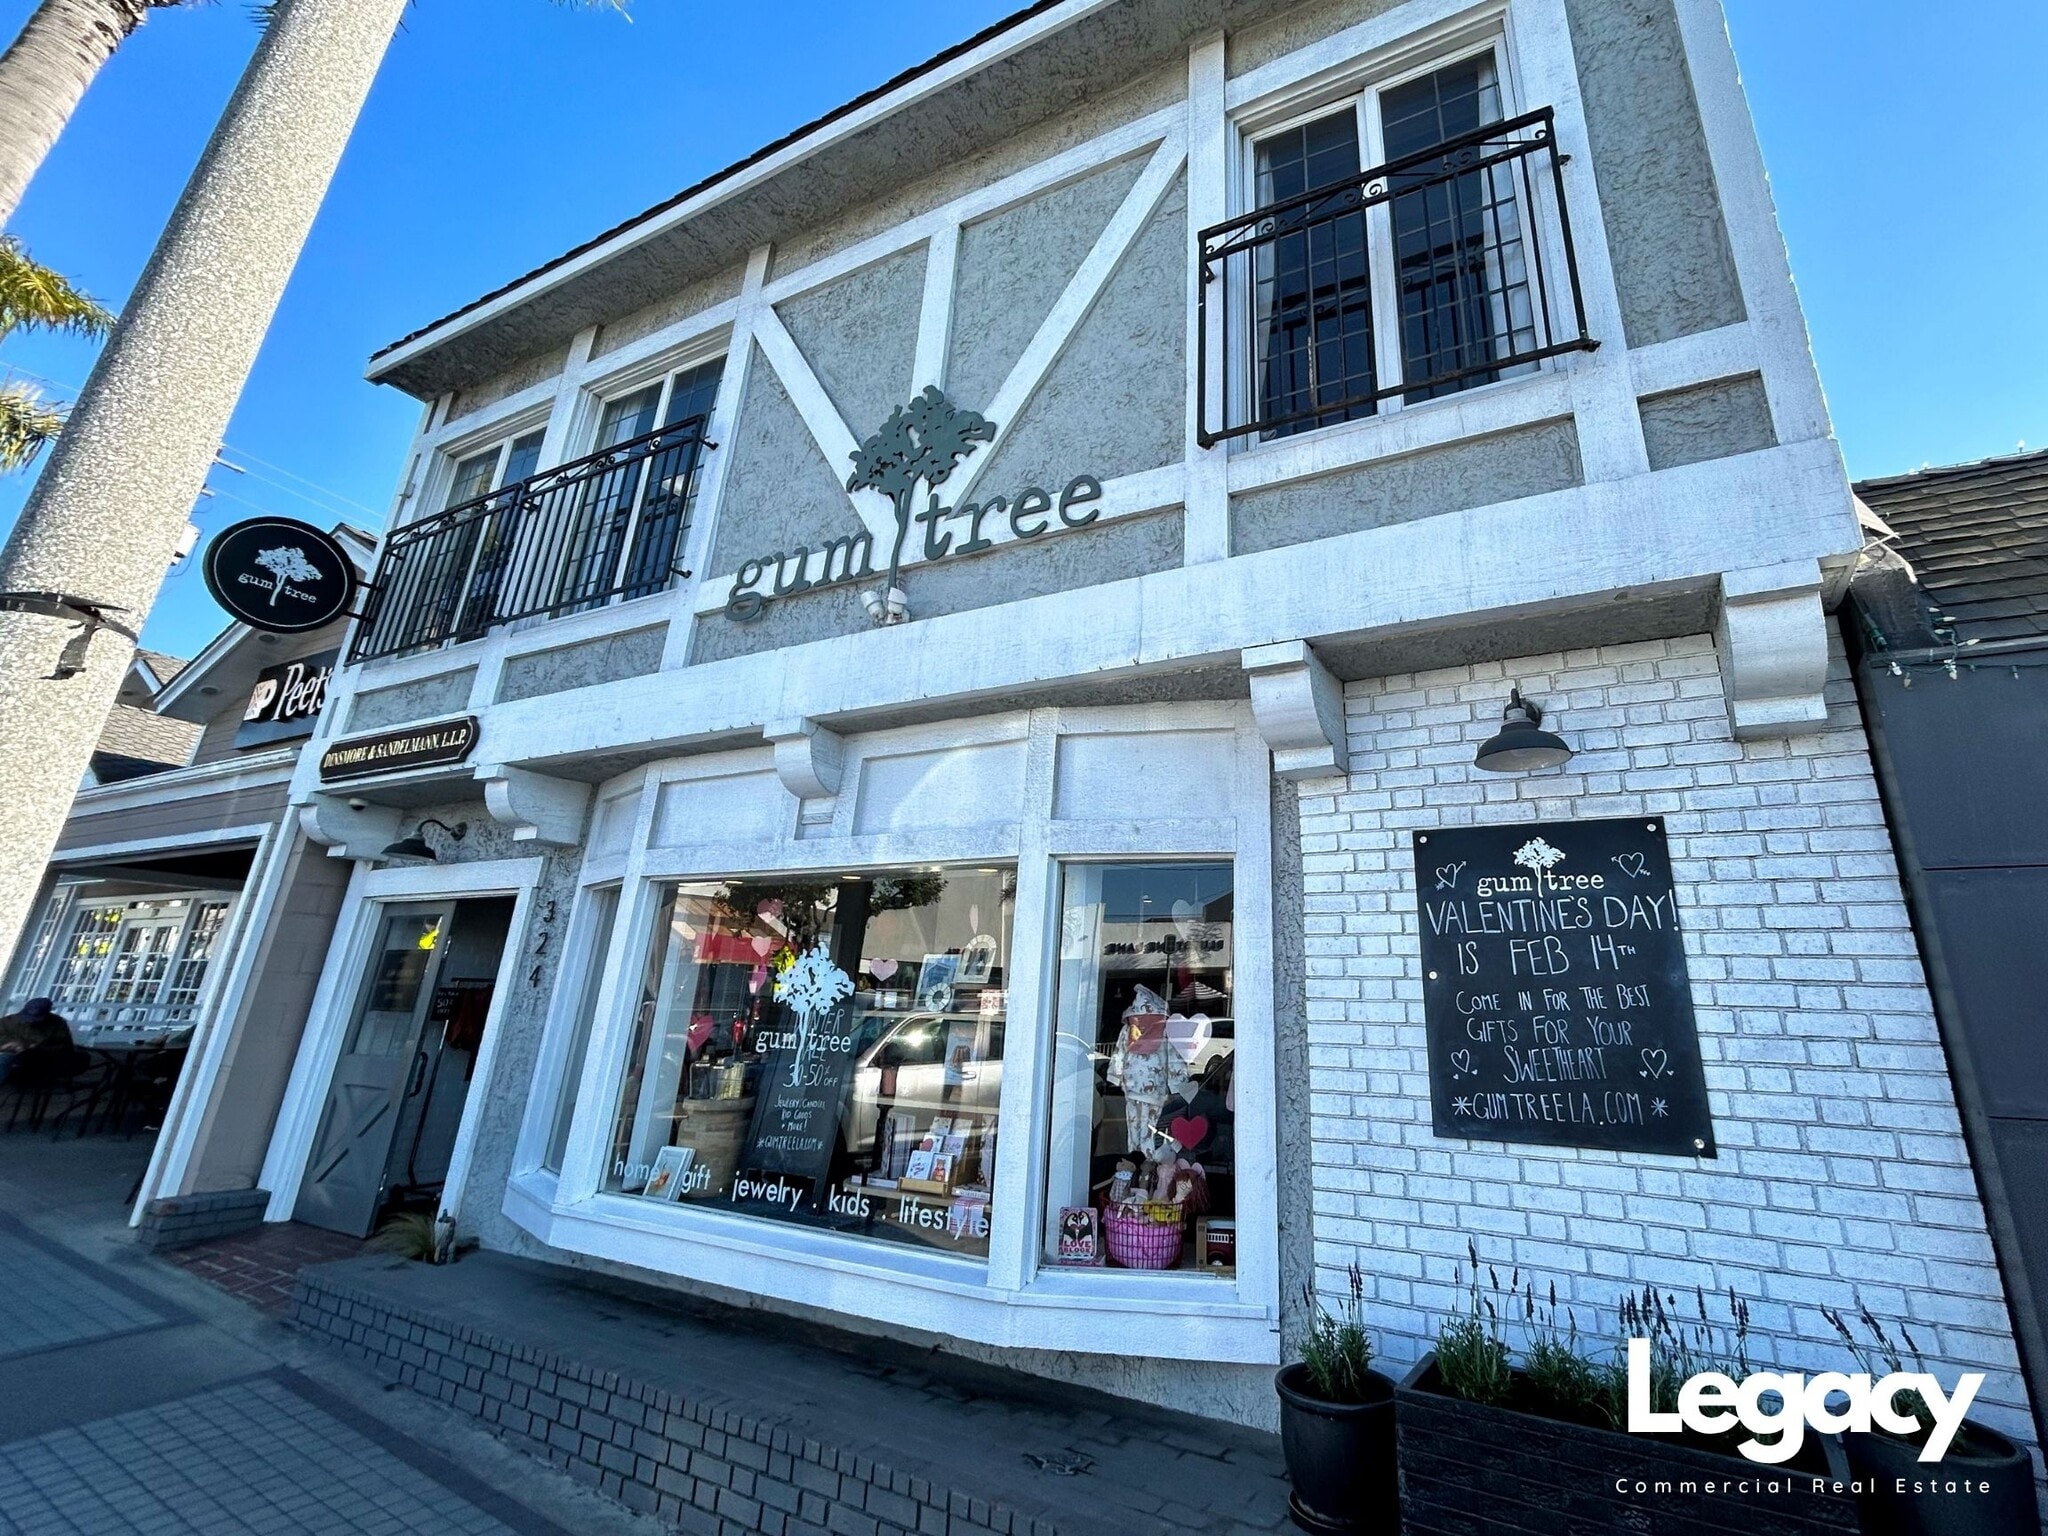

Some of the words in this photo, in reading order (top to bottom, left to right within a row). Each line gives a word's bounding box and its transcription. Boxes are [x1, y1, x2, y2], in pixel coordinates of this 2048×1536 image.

[724, 531, 874, 621] gum
[915, 474, 1101, 561] tree
[238, 572, 273, 590] gum
[284, 584, 317, 604] tree
[368, 745, 377, 760] &
[1477, 874, 1533, 897] gum
[1545, 869, 1605, 891] tree
[1603, 889, 1680, 932] DAY!
[1457, 941, 1480, 976] IS
[1509, 935, 1571, 976] FEB
[1456, 990, 1502, 1015] COME
[1518, 990, 1533, 1012] IN
[1544, 988, 1571, 1012] FOR
[1579, 985, 1605, 1010] THE
[1616, 983, 1652, 1009] BEST
[755, 1031, 797, 1053] gum
[807, 1028, 851, 1052] tree
[1466, 1018, 1519, 1043] GIFTS
[1532, 1015, 1570, 1046] FOR
[1586, 1016, 1634, 1046] YOUR
[1503, 1045, 1608, 1084] SWEETHEART
[614, 1152, 660, 1182] home
[681, 1164, 711, 1193] gift
[732, 1170, 803, 1212] jewelry
[828, 1184, 870, 1218] kids
[899, 1194, 989, 1240] lifestyle
[1064, 1240, 1091, 1248] LOVE
